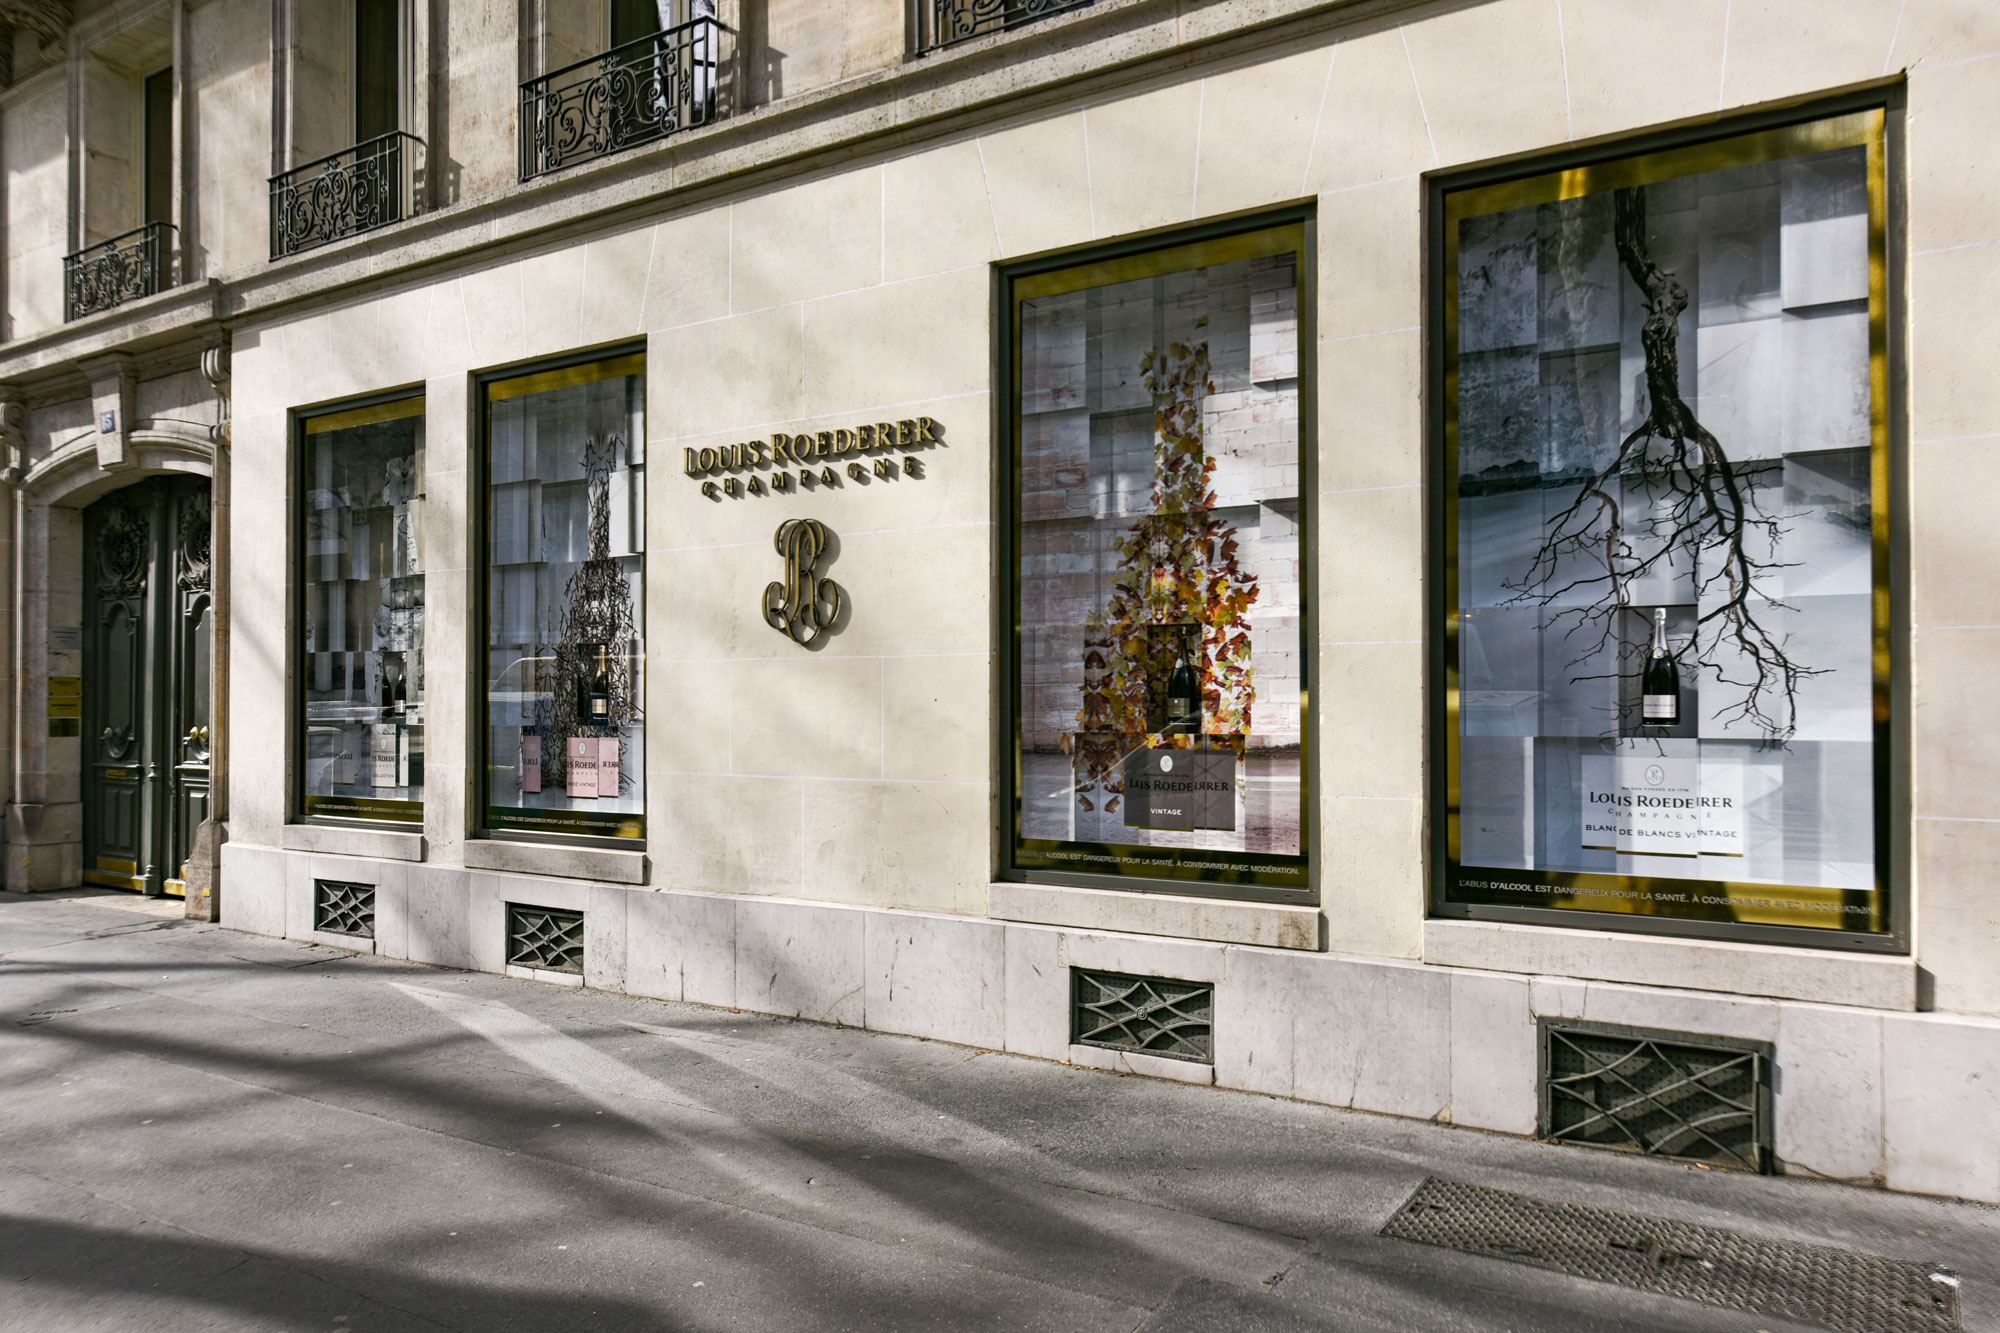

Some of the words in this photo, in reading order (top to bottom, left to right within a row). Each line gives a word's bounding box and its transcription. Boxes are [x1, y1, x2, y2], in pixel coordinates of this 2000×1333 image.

[684, 440, 762, 474] LOUIS
[771, 416, 936, 464] ROEDERER
[702, 456, 914, 496] CHAMPAGNE
[1150, 808, 1182, 816] VINTAGE
[1619, 828, 1633, 836] DE
[1637, 829, 1682, 838] BLANCS
[1122, 856, 1140, 865] POUR
[1230, 864, 1249, 872] AVEC
[1490, 881, 1533, 892] D'ALCOOL
[1535, 884, 1552, 893] EST
[1553, 885, 1609, 897] DANGEREUX
[1612, 890, 1638, 899] POUR
[1640, 892, 1652, 900] LA
[1693, 893, 1699, 903] À
